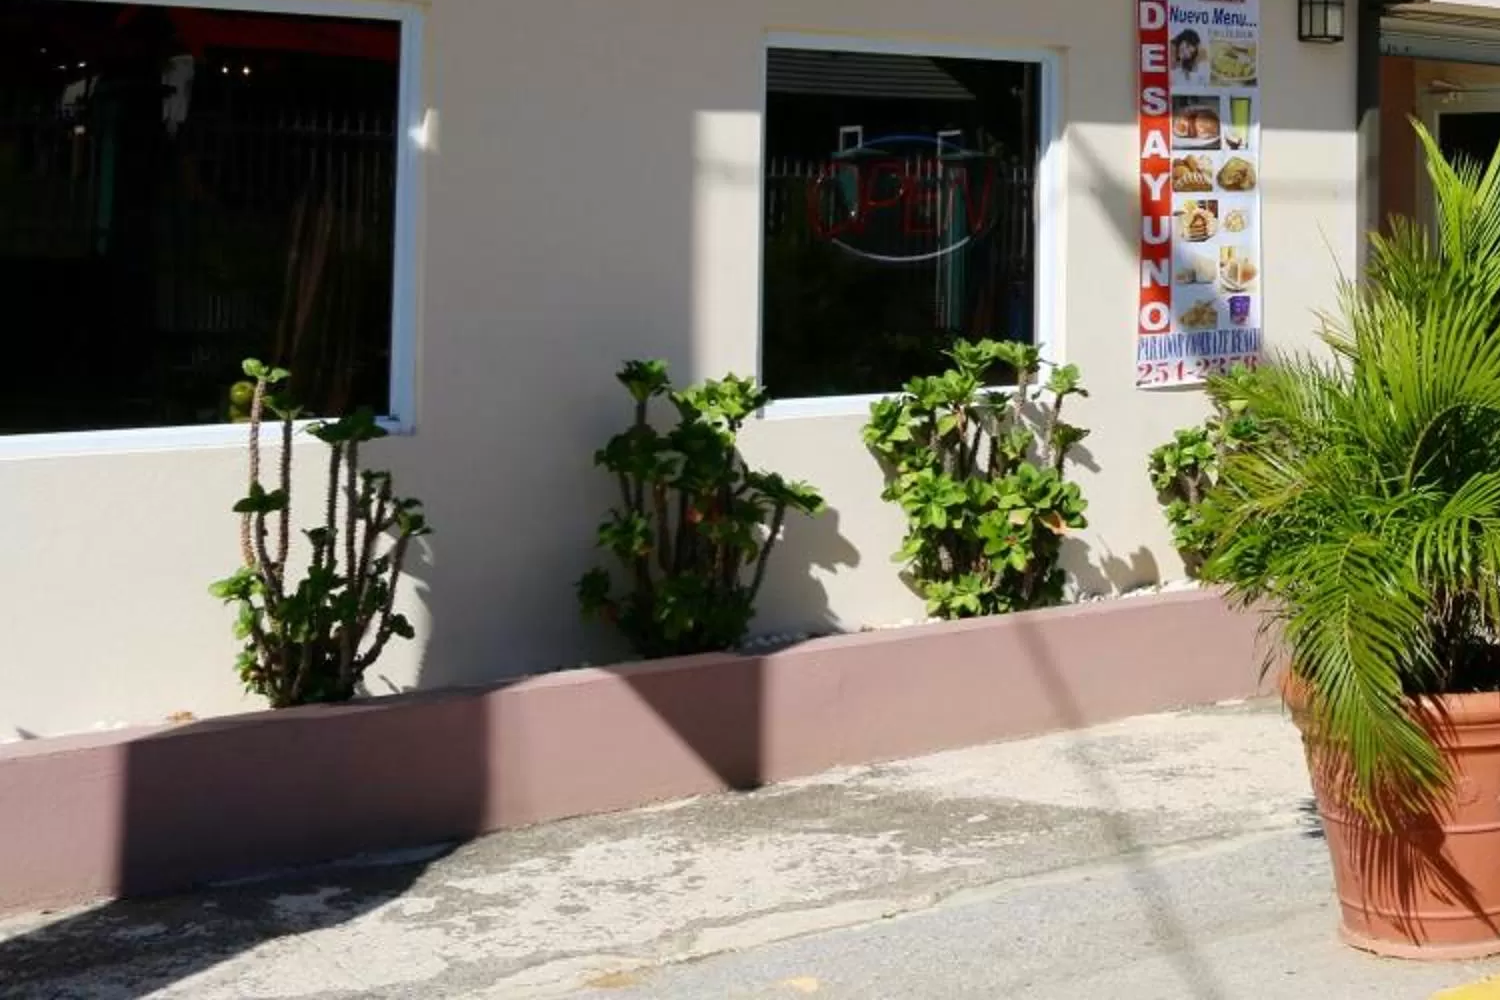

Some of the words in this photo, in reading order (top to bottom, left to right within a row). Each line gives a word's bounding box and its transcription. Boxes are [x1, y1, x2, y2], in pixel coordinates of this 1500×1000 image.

[1169, 6, 1209, 25] Nuevo
[807, 157, 994, 242] OPEN
[1139, 1, 1171, 332] DESAYUNO
